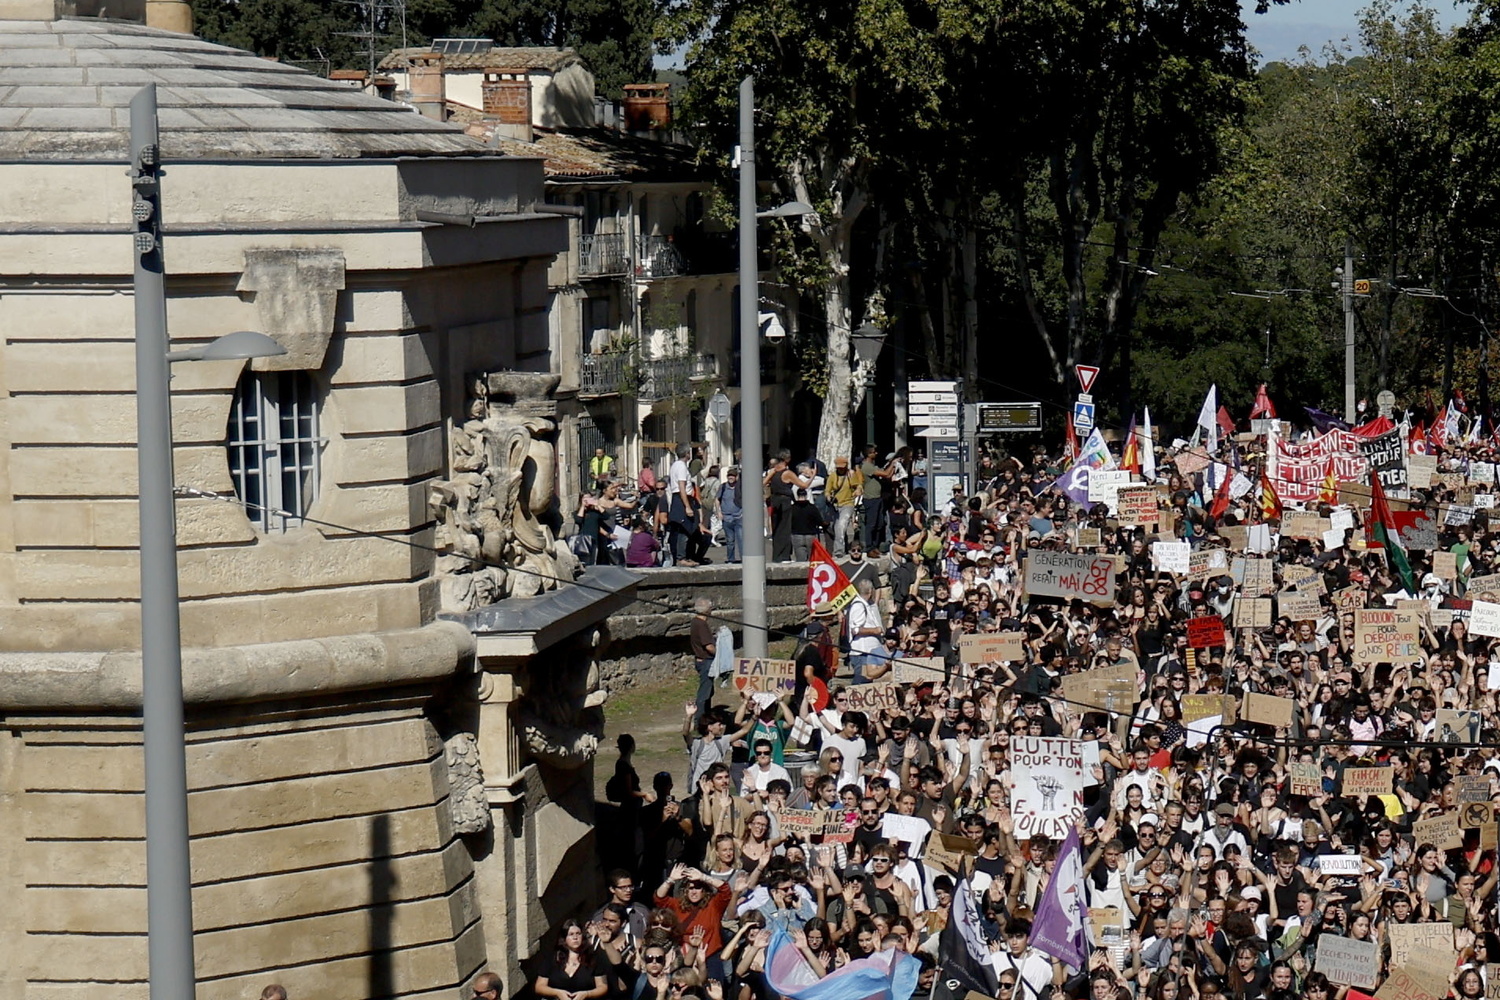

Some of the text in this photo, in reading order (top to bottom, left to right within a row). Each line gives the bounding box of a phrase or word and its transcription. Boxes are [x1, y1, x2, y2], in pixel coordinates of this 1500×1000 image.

[1091, 559, 1111, 579] 67
[1083, 574, 1107, 595] 68
[1377, 625, 1398, 633] POUR
[1367, 645, 1383, 654] NOS
[850, 687, 896, 709] ACAB
[1014, 739, 1080, 756] LUTTE
[1014, 755, 1082, 769] POUR TON
